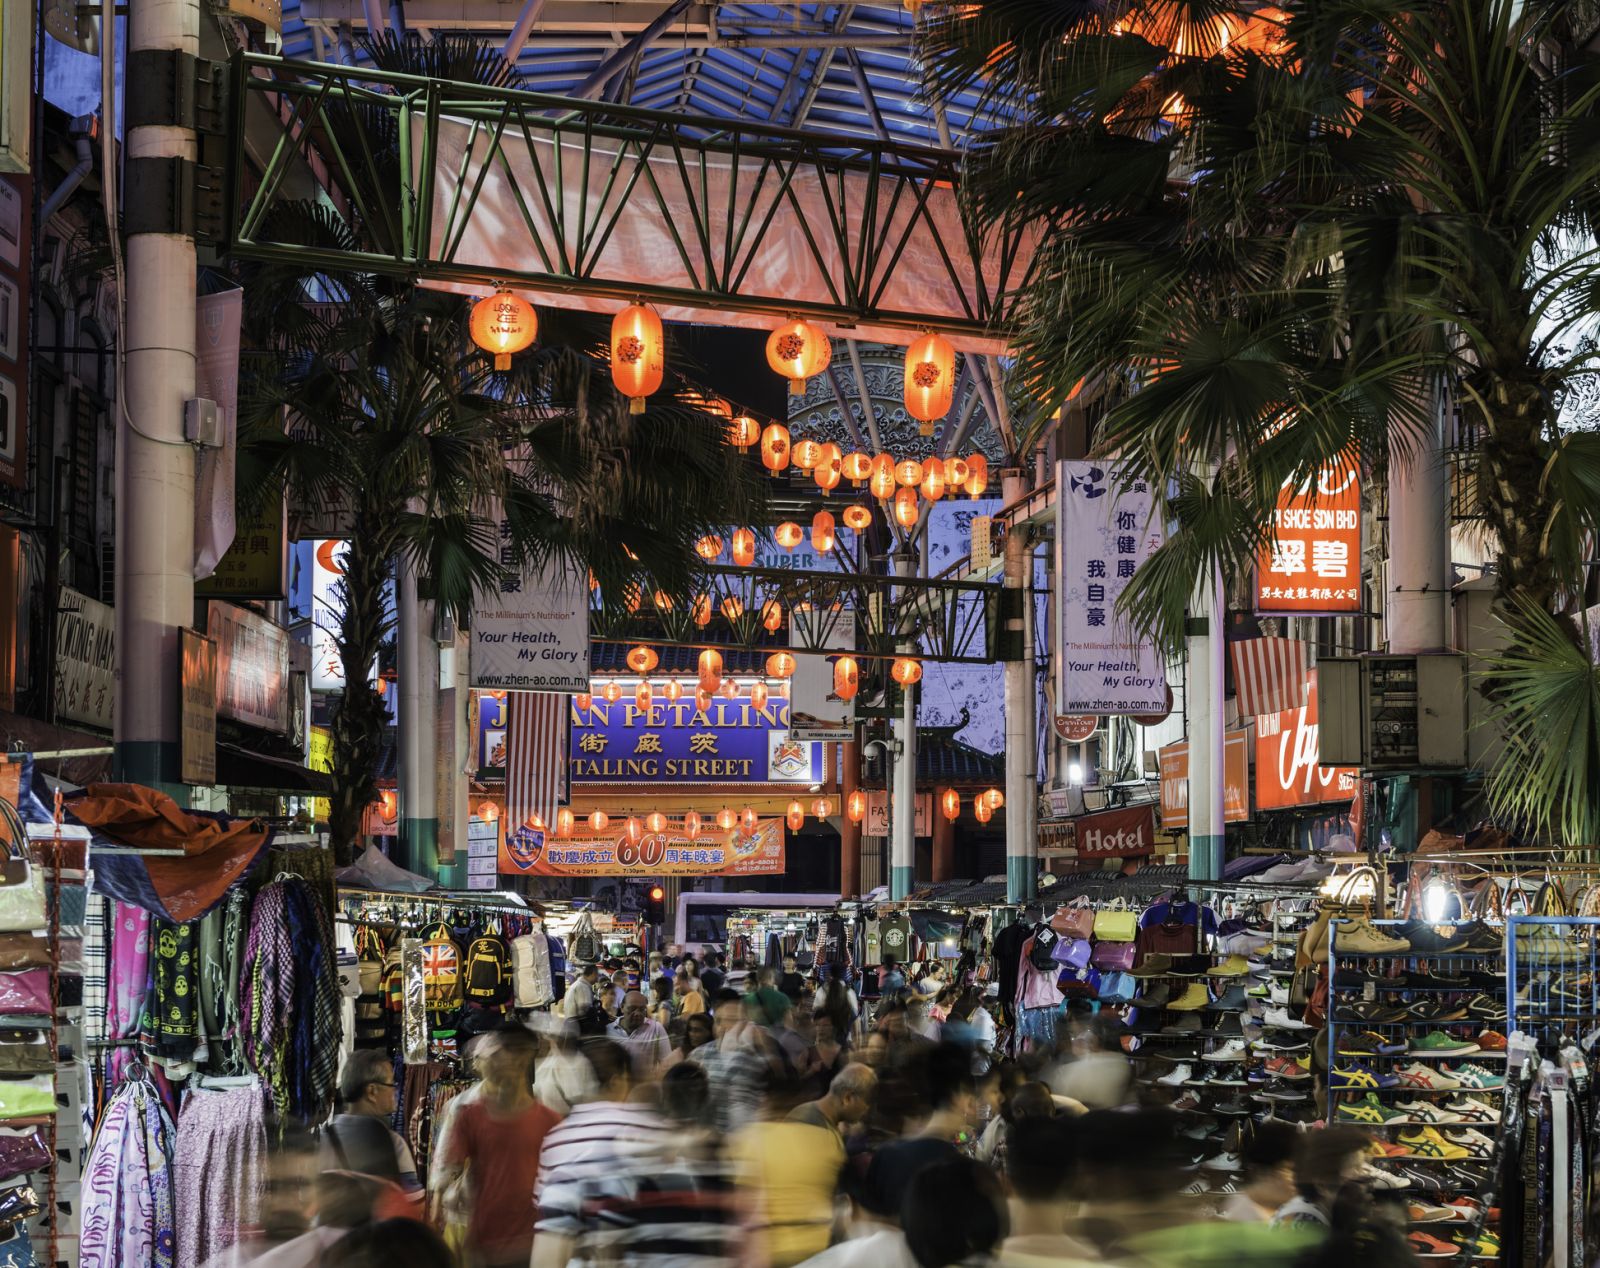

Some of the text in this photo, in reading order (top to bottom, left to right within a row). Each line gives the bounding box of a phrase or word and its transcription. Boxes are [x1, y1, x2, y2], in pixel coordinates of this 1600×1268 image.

[1283, 509, 1312, 529] SHOE
[1313, 509, 1334, 529] SDN
[1336, 509, 1357, 529] BHD
[1117, 511, 1136, 578] 你健康
[755, 553, 814, 569] SUPER
[1087, 559, 1105, 627] 我自豪
[58, 612, 95, 663] KWONG
[478, 631, 561, 645] Your Health,
[517, 649, 538, 662] My
[541, 649, 578, 663] Glory
[1069, 661, 1140, 673] Your Health,
[477, 673, 588, 689] www.zhen-ao.com.my
[1103, 676, 1120, 688] My
[1123, 676, 1155, 689] Glory
[1068, 699, 1166, 712] www.zhen-ao.com.my
[665, 759, 754, 776] STREET
[1085, 824, 1145, 852] Hotel
[665, 849, 725, 864] 周年晚宴
